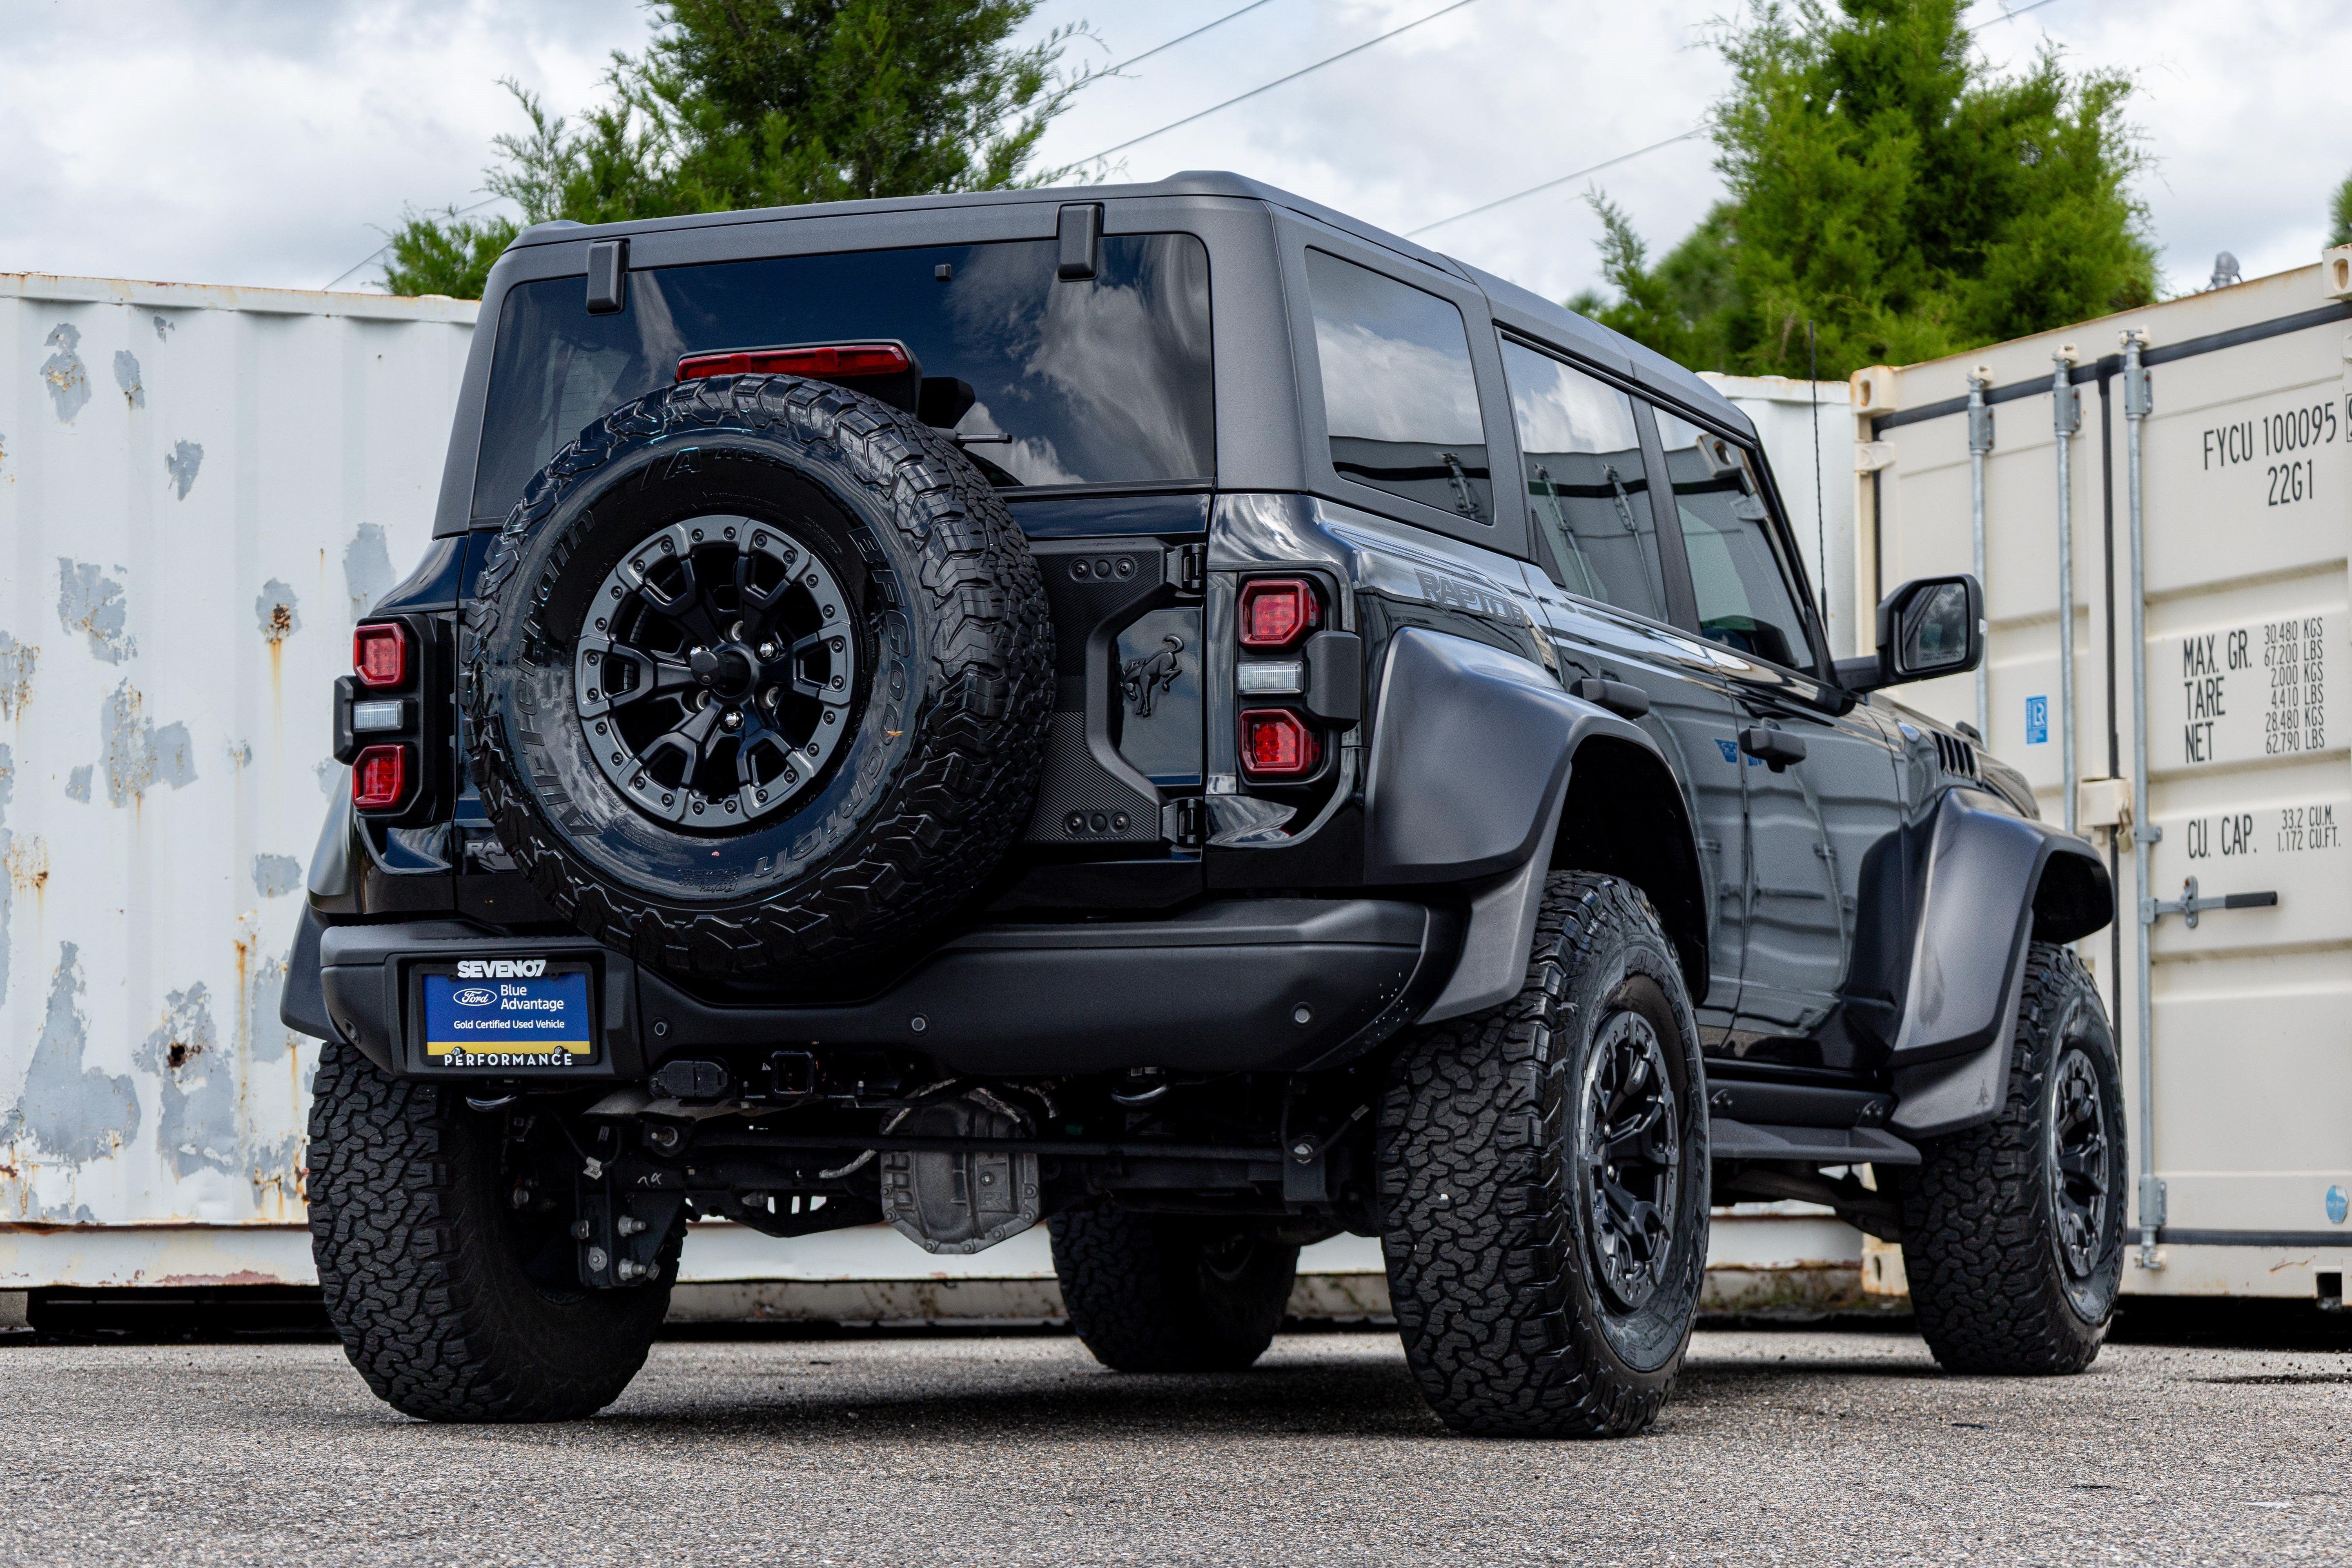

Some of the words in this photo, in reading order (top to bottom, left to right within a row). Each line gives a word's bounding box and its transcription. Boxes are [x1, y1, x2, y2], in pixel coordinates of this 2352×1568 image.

[2203, 420, 2253, 470] FYCU
[2263, 401, 2336, 456] 100095
[2267, 458, 2313, 506] 22G1
[2183, 633, 2220, 678] MAX.
[2228, 628, 2252, 670] GR.
[2303, 617, 2323, 639] KGS
[2304, 639, 2323, 661] LBS
[754, 526, 911, 878] BFGoodrich
[2184, 675, 2226, 721] TARE
[2304, 661, 2323, 683] KGS
[2304, 683, 2323, 705] LBS
[2185, 721, 2214, 764] NET
[2305, 706, 2324, 727] KGS
[2305, 728, 2325, 750] LBS
[2188, 818, 2211, 858] CU.
[2222, 813, 2257, 855] CAP.
[2282, 808, 2303, 829] 33.2
[461, 989, 489, 1004] Ford
[501, 984, 527, 996] Blue
[501, 998, 564, 1012] Advantage
[454, 1020, 474, 1029] Gold
[475, 1020, 510, 1029] Certified
[513, 1020, 534, 1029] Used
[536, 1020, 565, 1029] Vehicle
[444, 1054, 572, 1067] PERFORMANCE
